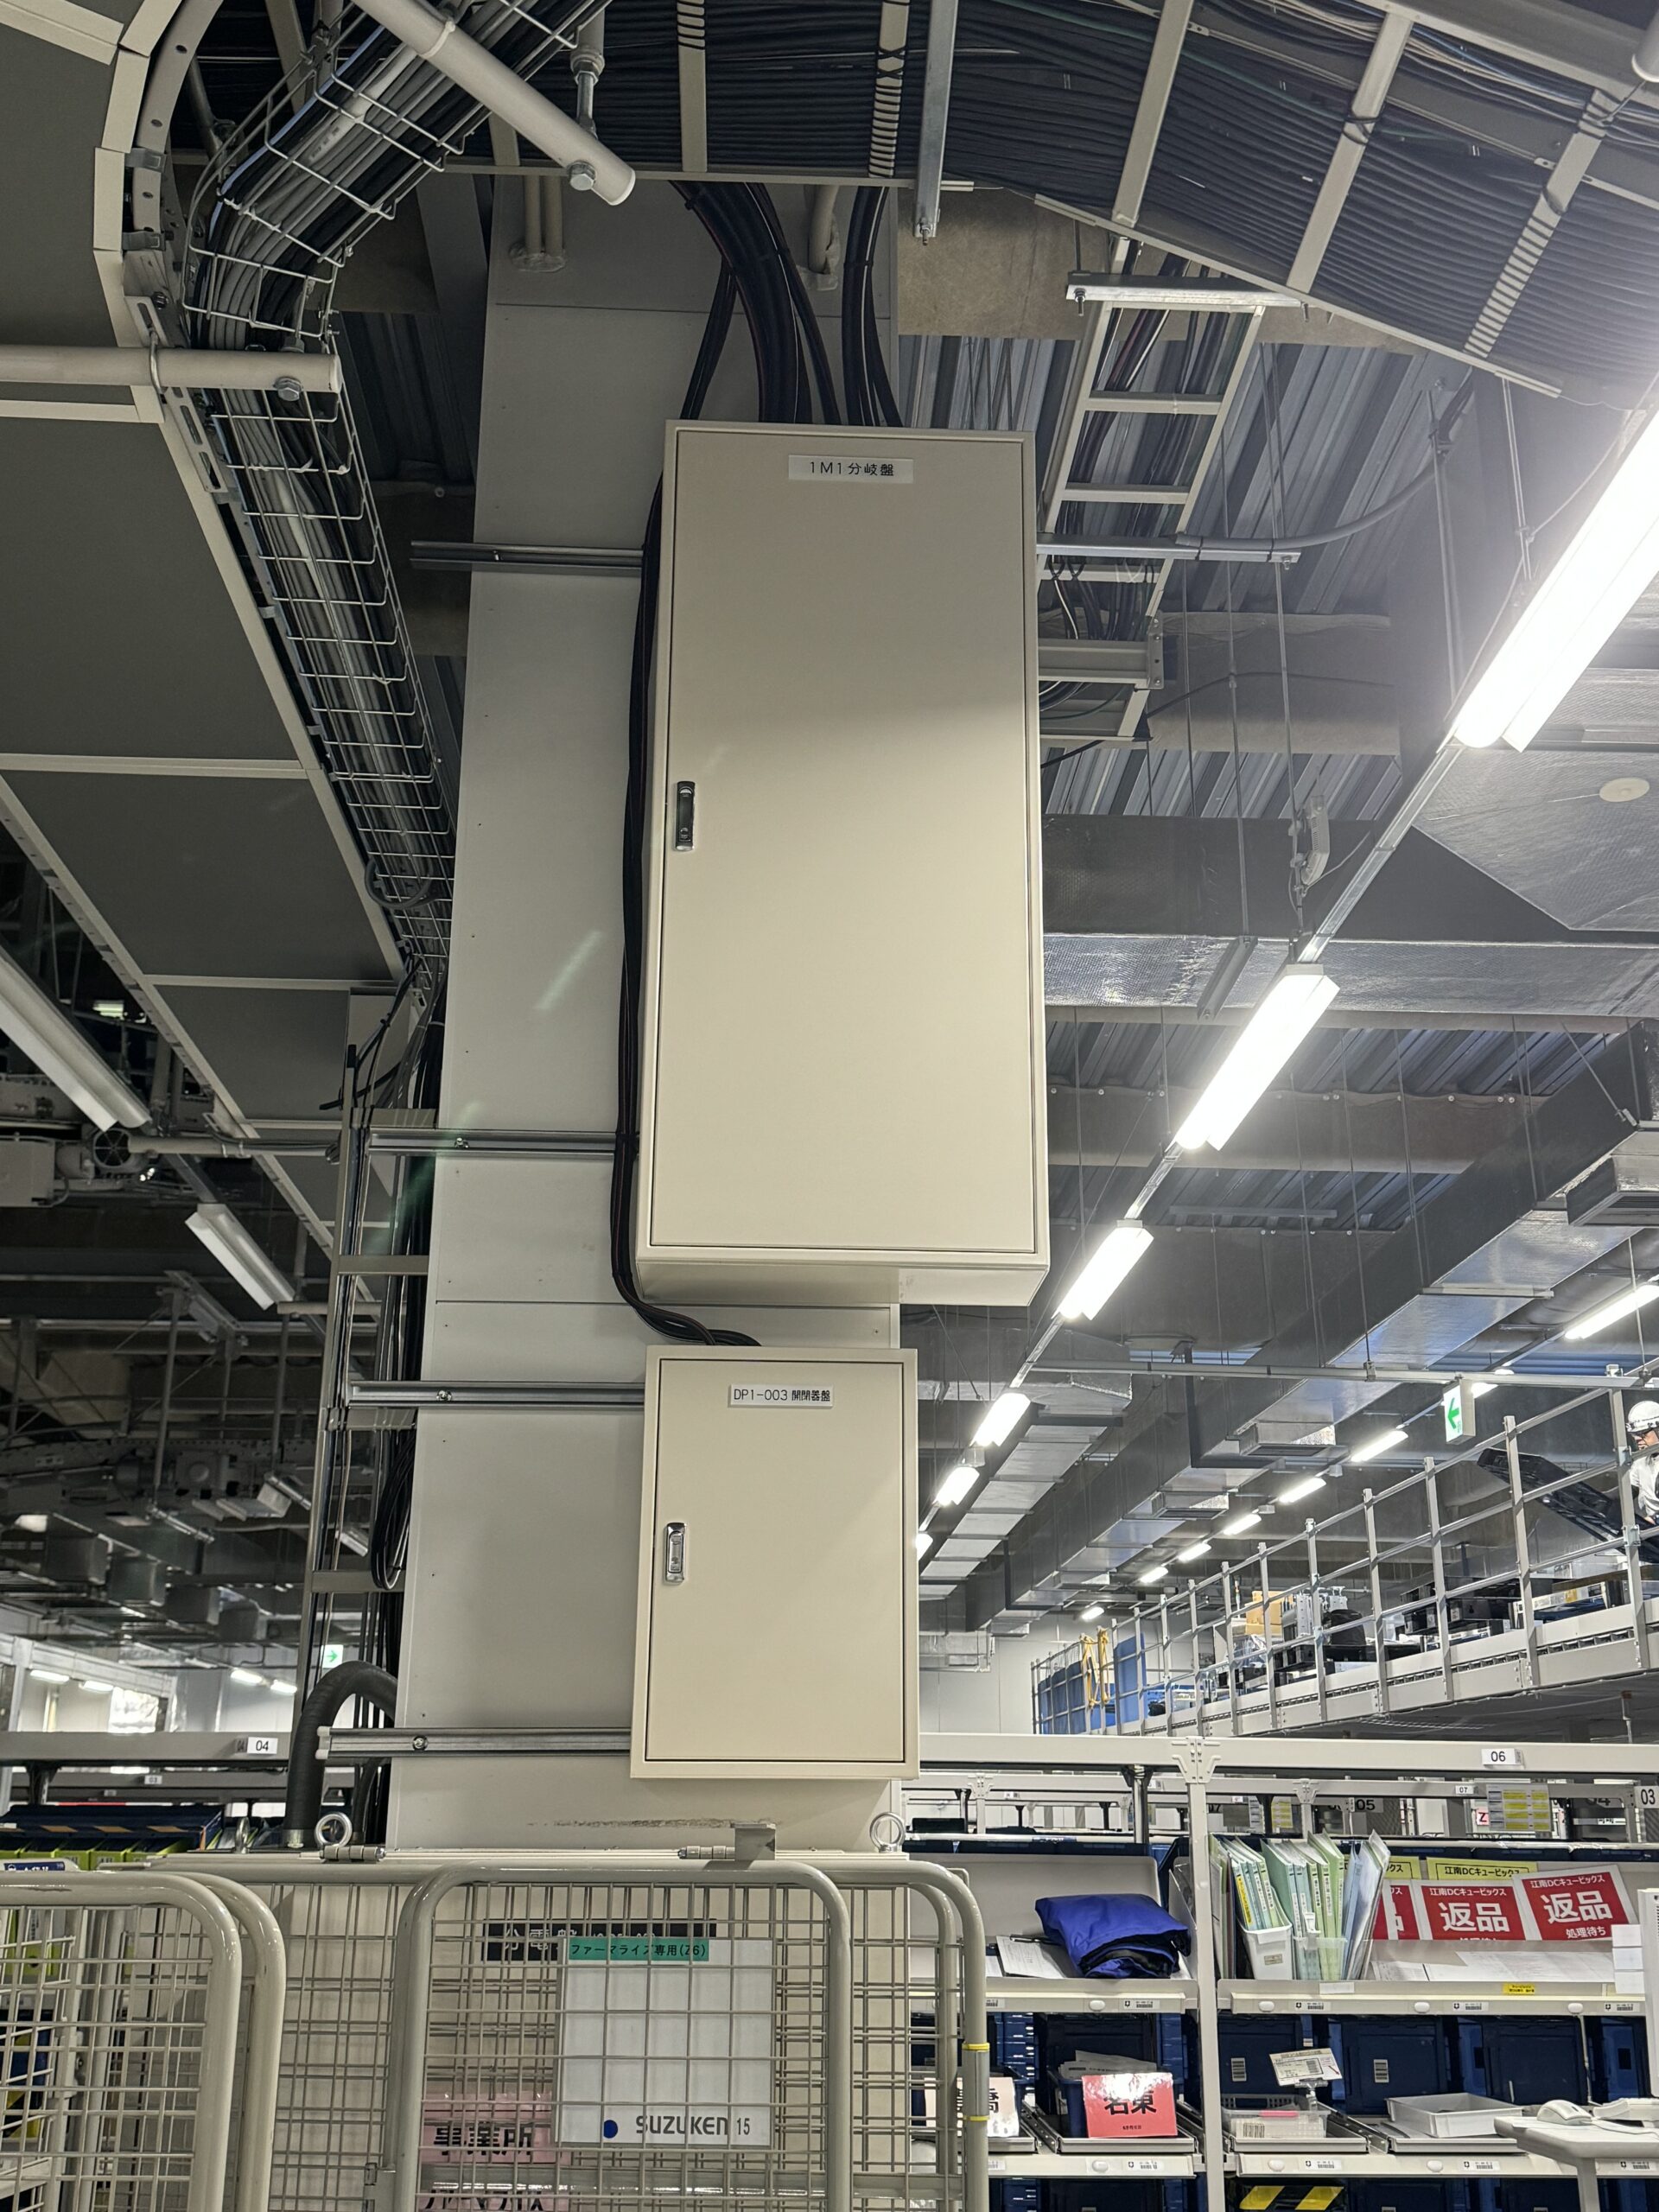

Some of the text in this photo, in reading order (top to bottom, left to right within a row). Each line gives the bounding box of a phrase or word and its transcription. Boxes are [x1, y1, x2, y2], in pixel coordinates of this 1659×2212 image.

[810, 461, 894, 477] 1M1分岐盤
[734, 1389, 830, 1402] DP1-003 開閉器盤
[256, 1740, 269, 1751] 04
[1491, 1751, 1506, 1762] 06
[1356, 1799, 1376, 1810] 05
[1641, 1789, 1656, 1805] 03
[1541, 1891, 1613, 1924] 返品
[1438, 1902, 1510, 1932] 返品
[1566, 1925, 1606, 1939] 処理待ち
[635, 2115, 751, 2135] SUZUKEN 15
